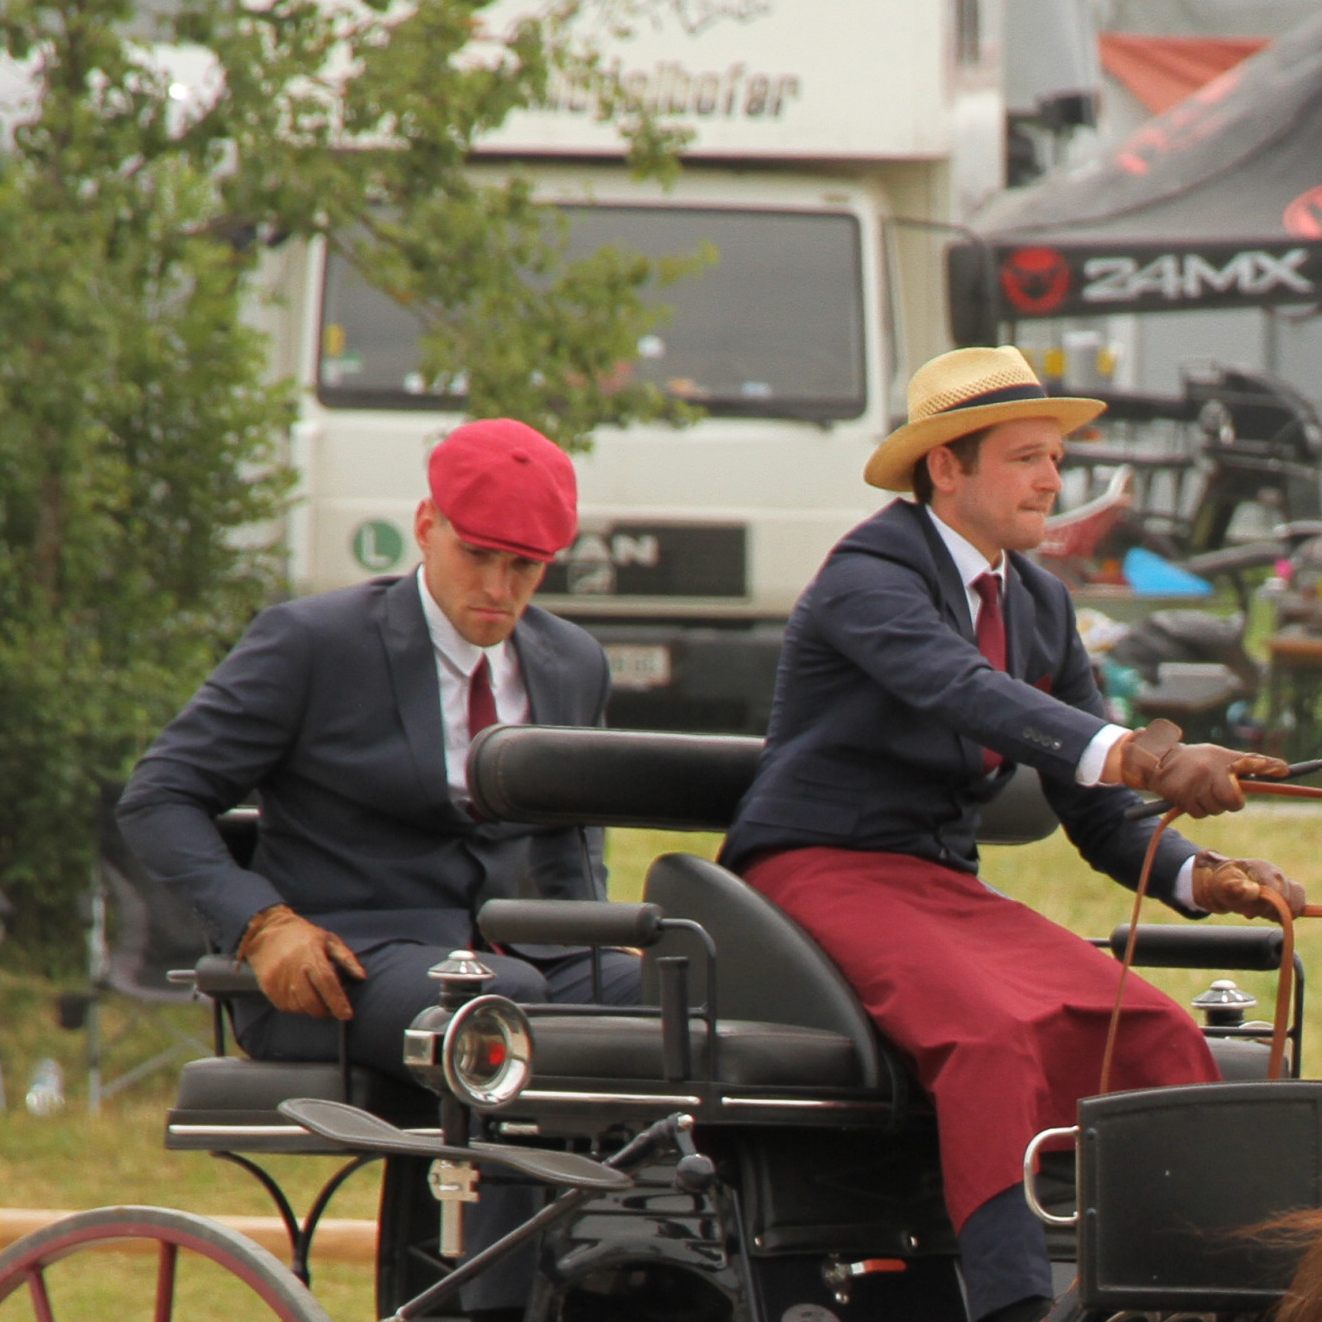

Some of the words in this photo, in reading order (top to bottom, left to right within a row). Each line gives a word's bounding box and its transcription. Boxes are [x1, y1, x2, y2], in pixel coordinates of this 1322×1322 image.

[1083, 247, 1316, 301] 24MX
[361, 523, 392, 568] L
[554, 532, 659, 568] AN
